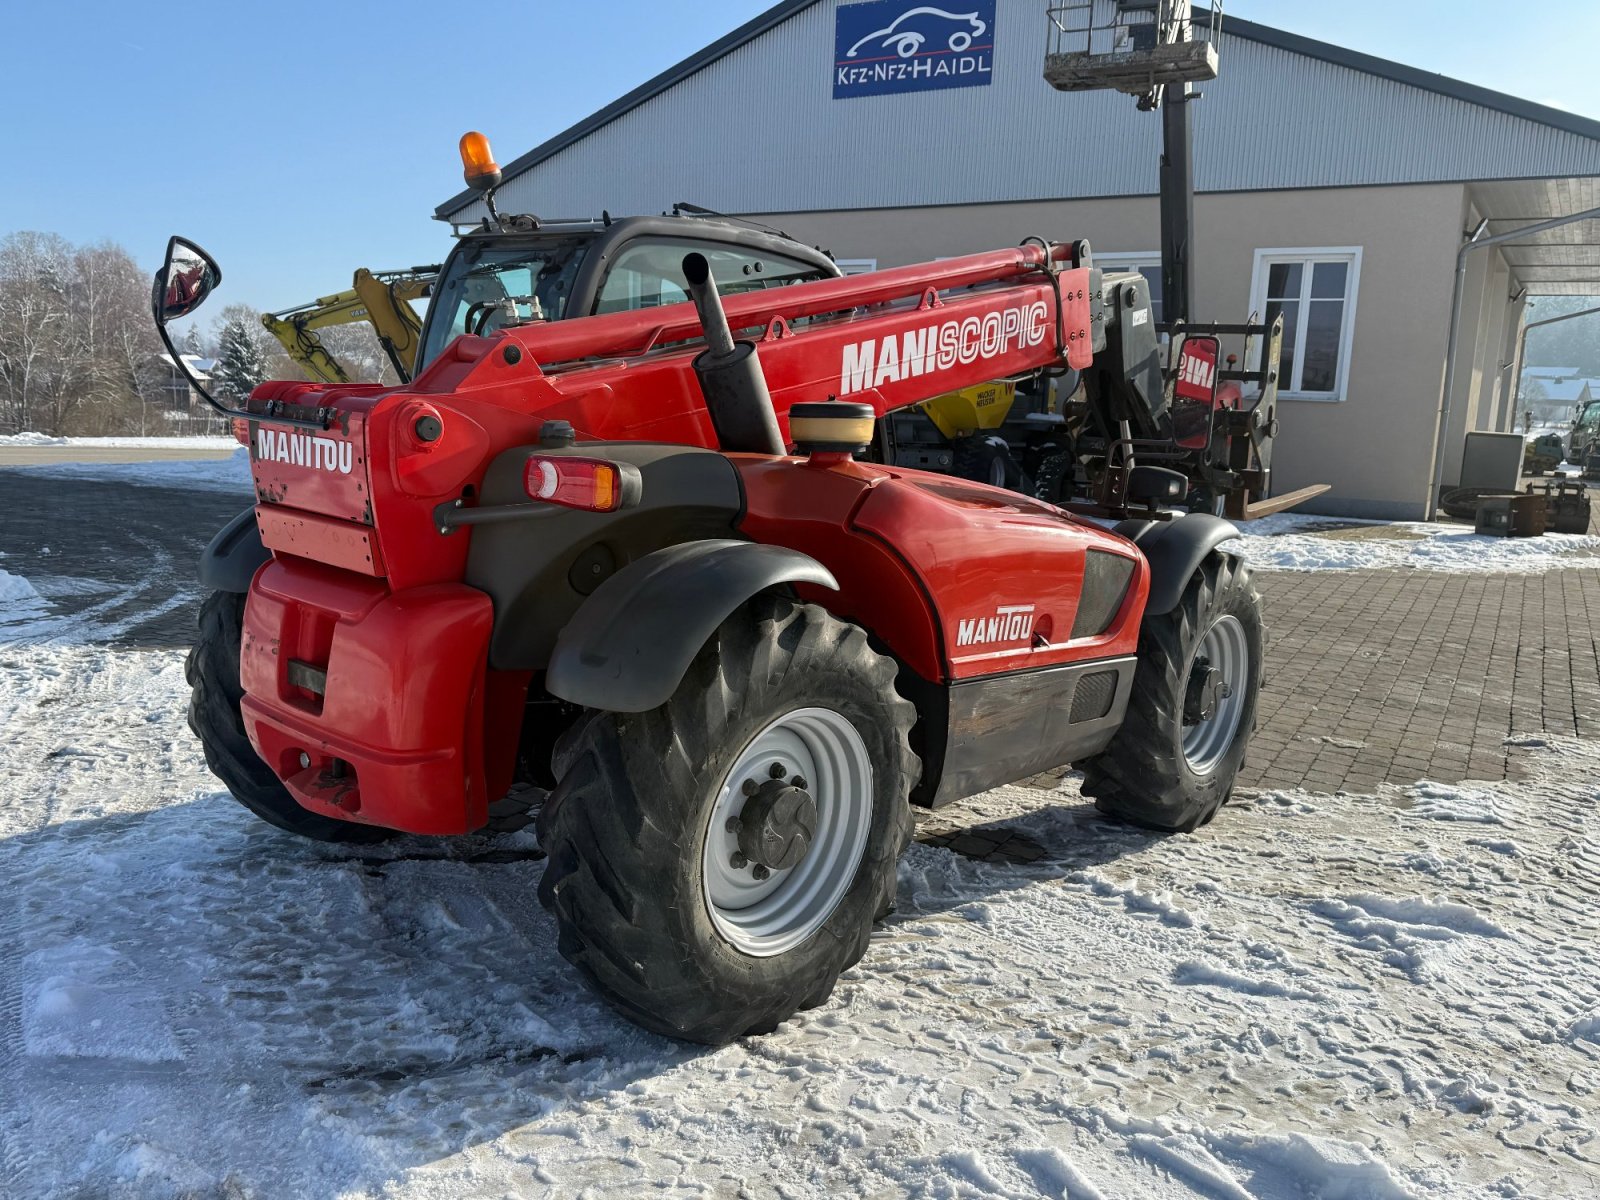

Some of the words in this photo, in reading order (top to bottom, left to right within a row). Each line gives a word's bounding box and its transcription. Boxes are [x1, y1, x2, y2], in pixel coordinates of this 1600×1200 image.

[840, 301, 1048, 396] MANISCOPIC
[257, 428, 353, 474] MANITOU
[956, 603, 1035, 647] MANITOU
